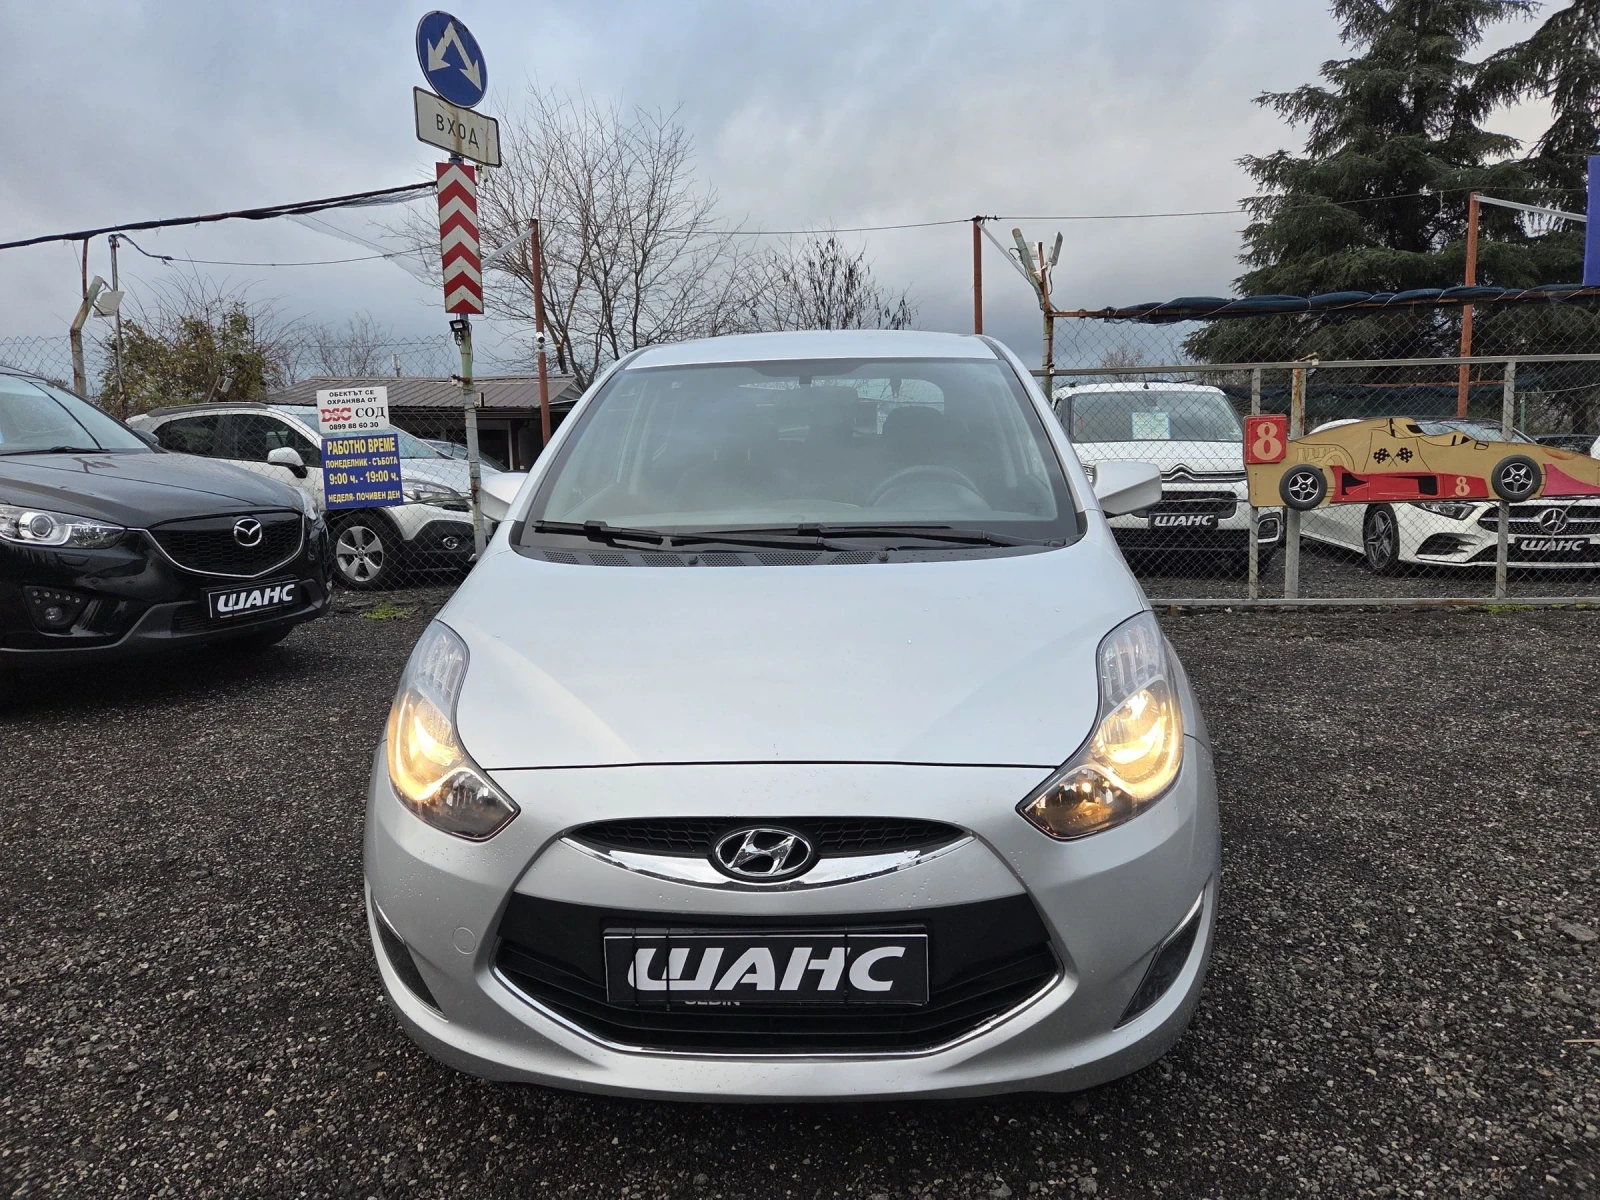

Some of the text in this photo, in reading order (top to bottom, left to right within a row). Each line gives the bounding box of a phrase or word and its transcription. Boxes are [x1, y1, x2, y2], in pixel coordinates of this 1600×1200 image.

[436, 113, 479, 150] ВХОД
[327, 397, 365, 405] ОХРАНЯВА
[321, 406, 386, 422] DSC СОД
[327, 437, 396, 455] РАБОТНО ВРЕМЕ
[1252, 421, 1282, 461] 8
[325, 458, 368, 469] ПОНЕДЕЛНИК
[372, 456, 398, 466] СЪБОТА
[329, 472, 348, 485] 9:00
[365, 470, 389, 482] 19:00
[1455, 476, 1470, 497] 8
[356, 491, 386, 500] ПОЧИВЕН
[387, 490, 400, 500] ДЕН
[1154, 514, 1214, 527] ШАНС
[1520, 540, 1585, 551] ШАНС
[217, 584, 295, 612] ШАНС
[627, 946, 906, 992] ШАНС
